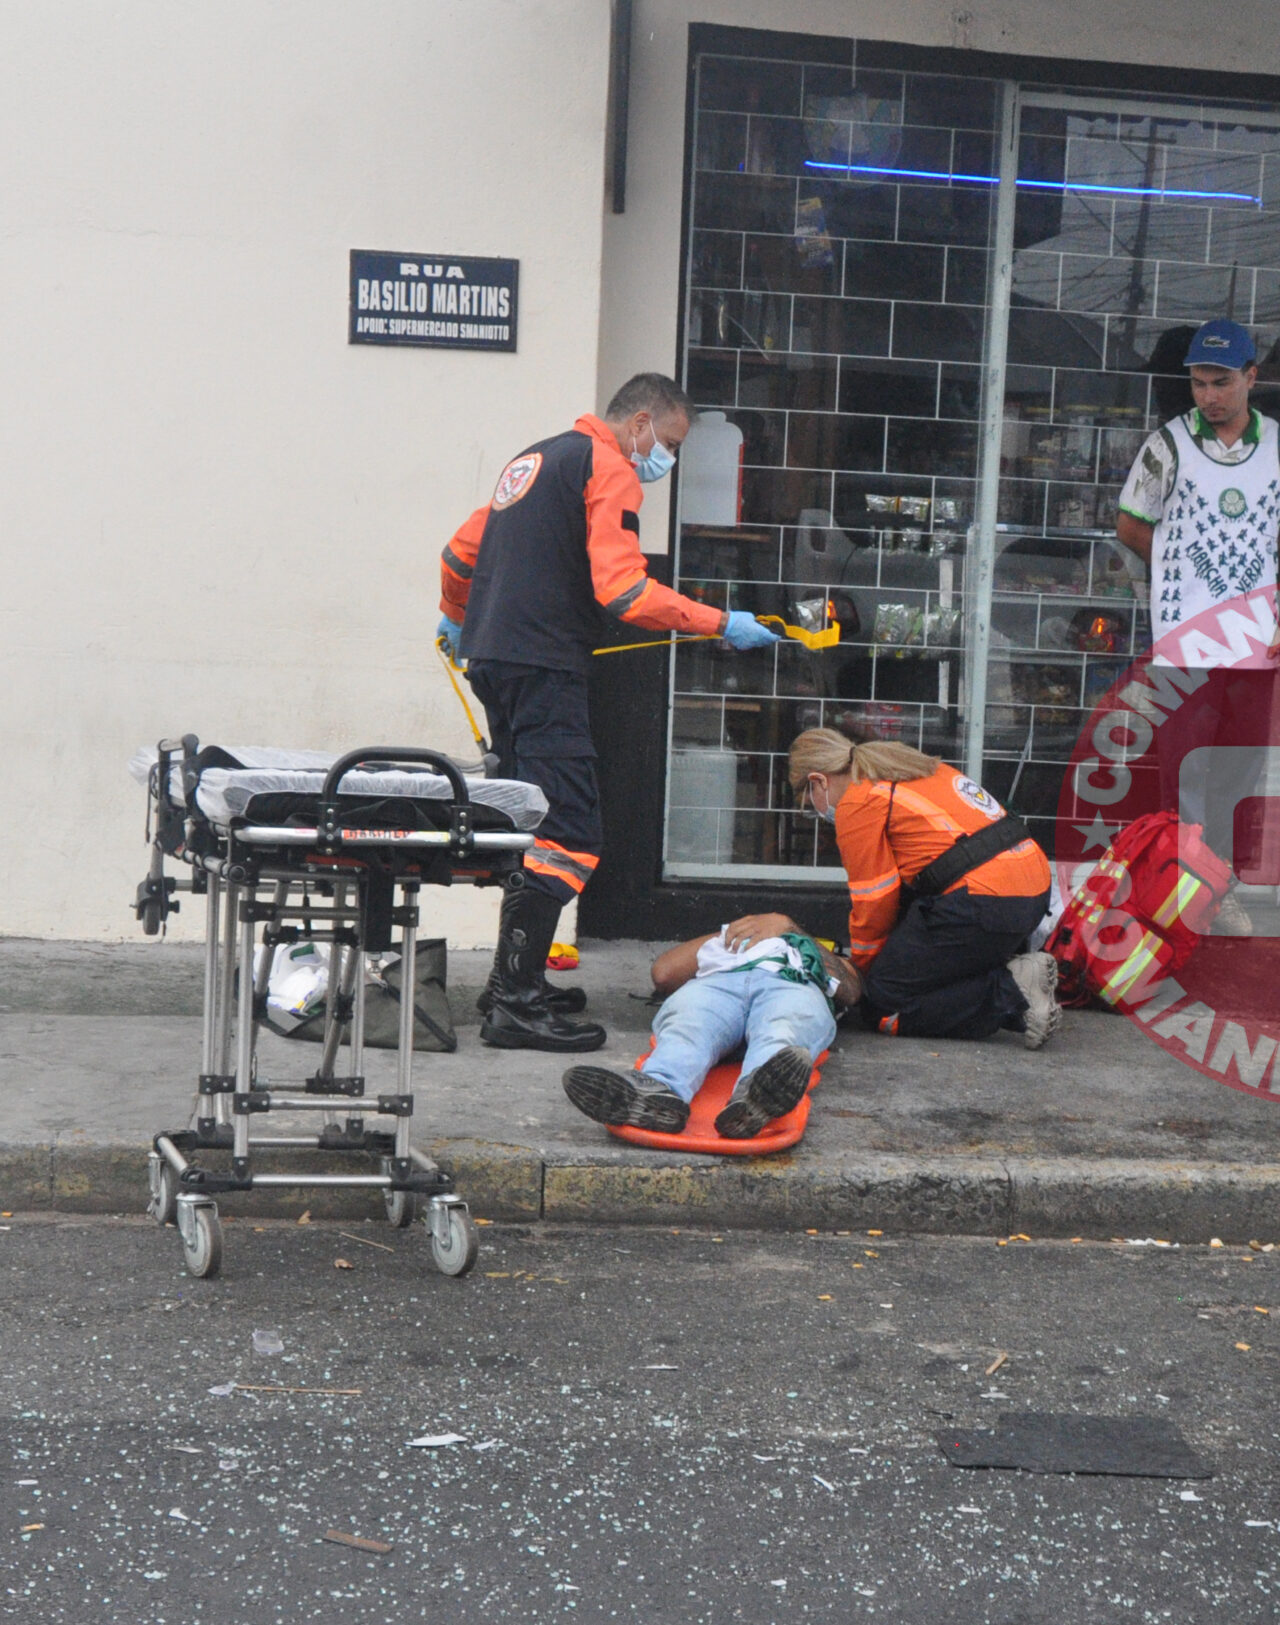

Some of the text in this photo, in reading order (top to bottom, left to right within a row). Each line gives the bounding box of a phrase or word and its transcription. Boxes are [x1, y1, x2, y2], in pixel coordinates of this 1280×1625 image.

[400, 263, 465, 279] RUA
[358, 279, 510, 318] BASILIO MARTINS
[357, 317, 510, 341] APOIO: SUPERMERCADO SMANIOTTO
[1185, 540, 1228, 599] MANCHA
[1235, 550, 1265, 600] VERDE
